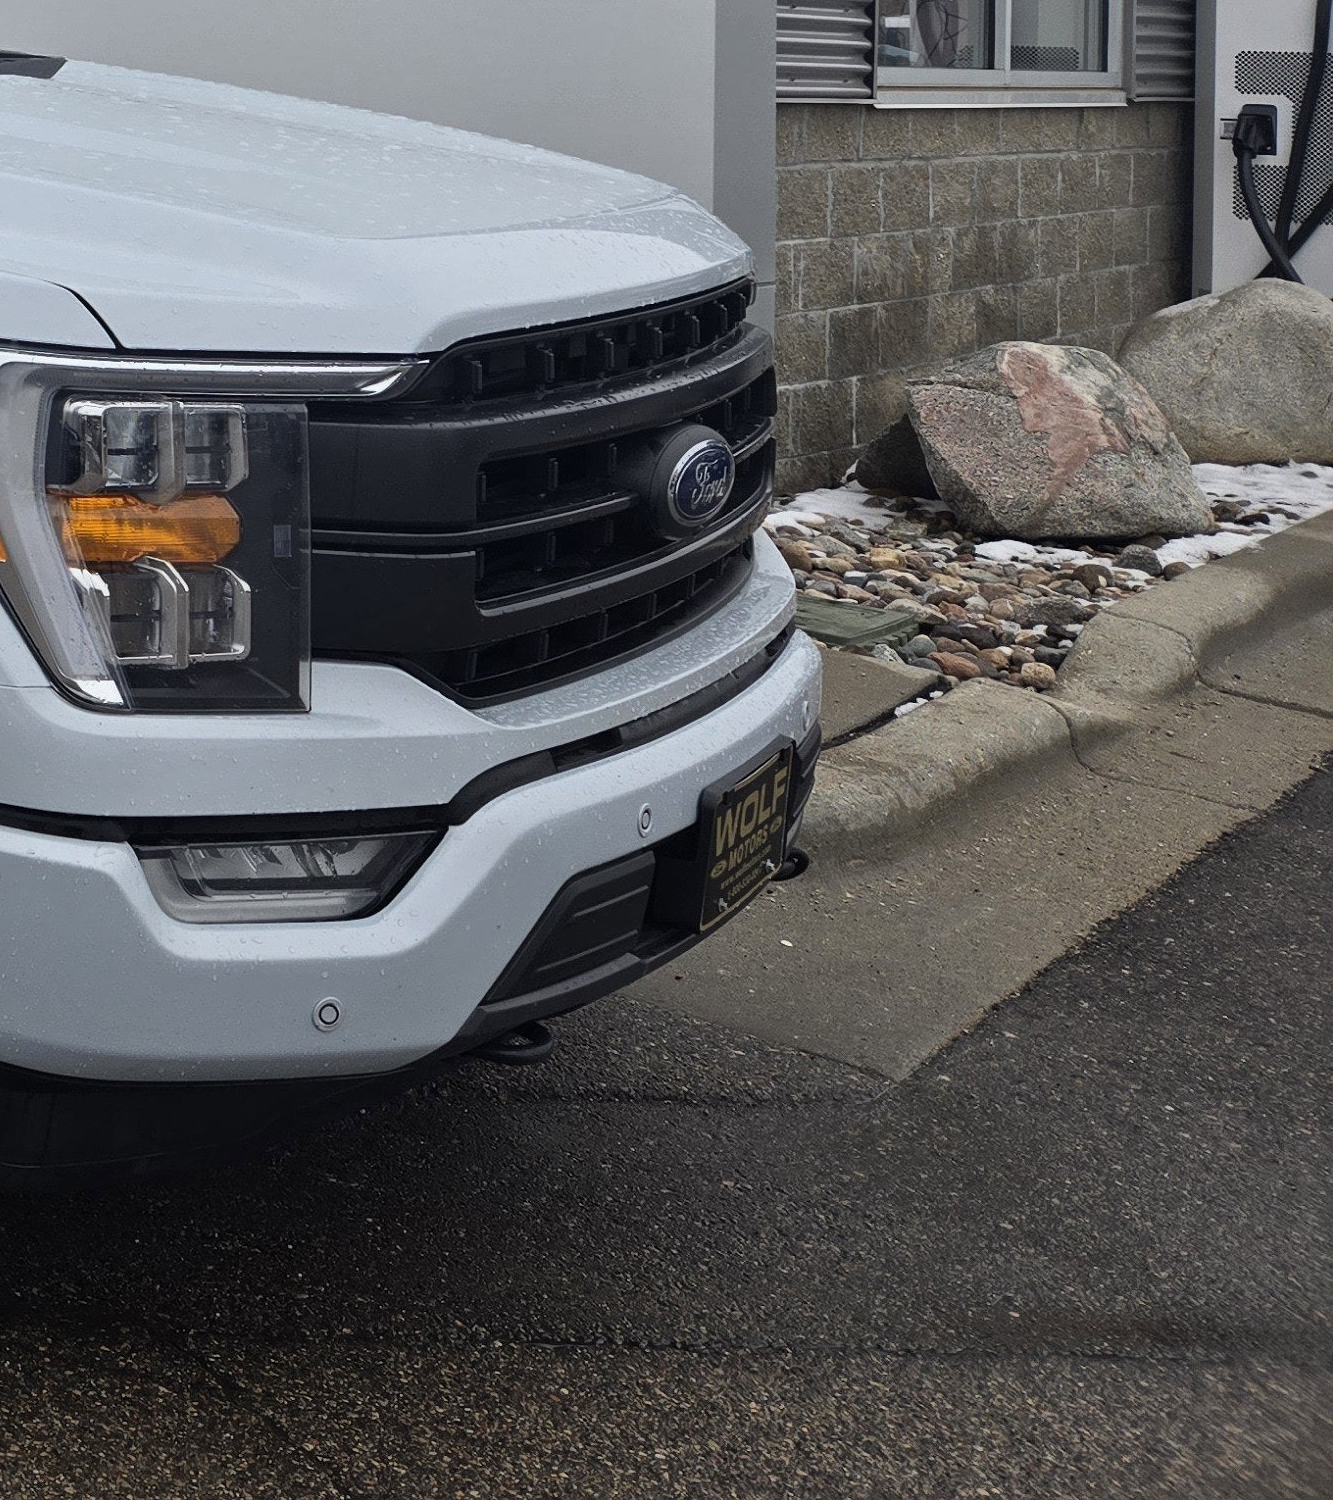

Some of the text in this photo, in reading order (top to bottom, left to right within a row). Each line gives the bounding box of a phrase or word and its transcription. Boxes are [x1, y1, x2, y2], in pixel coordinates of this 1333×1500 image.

[690, 459, 728, 510] Ford
[715, 765, 789, 857] WOLF
[727, 824, 770, 871] MOTORS
